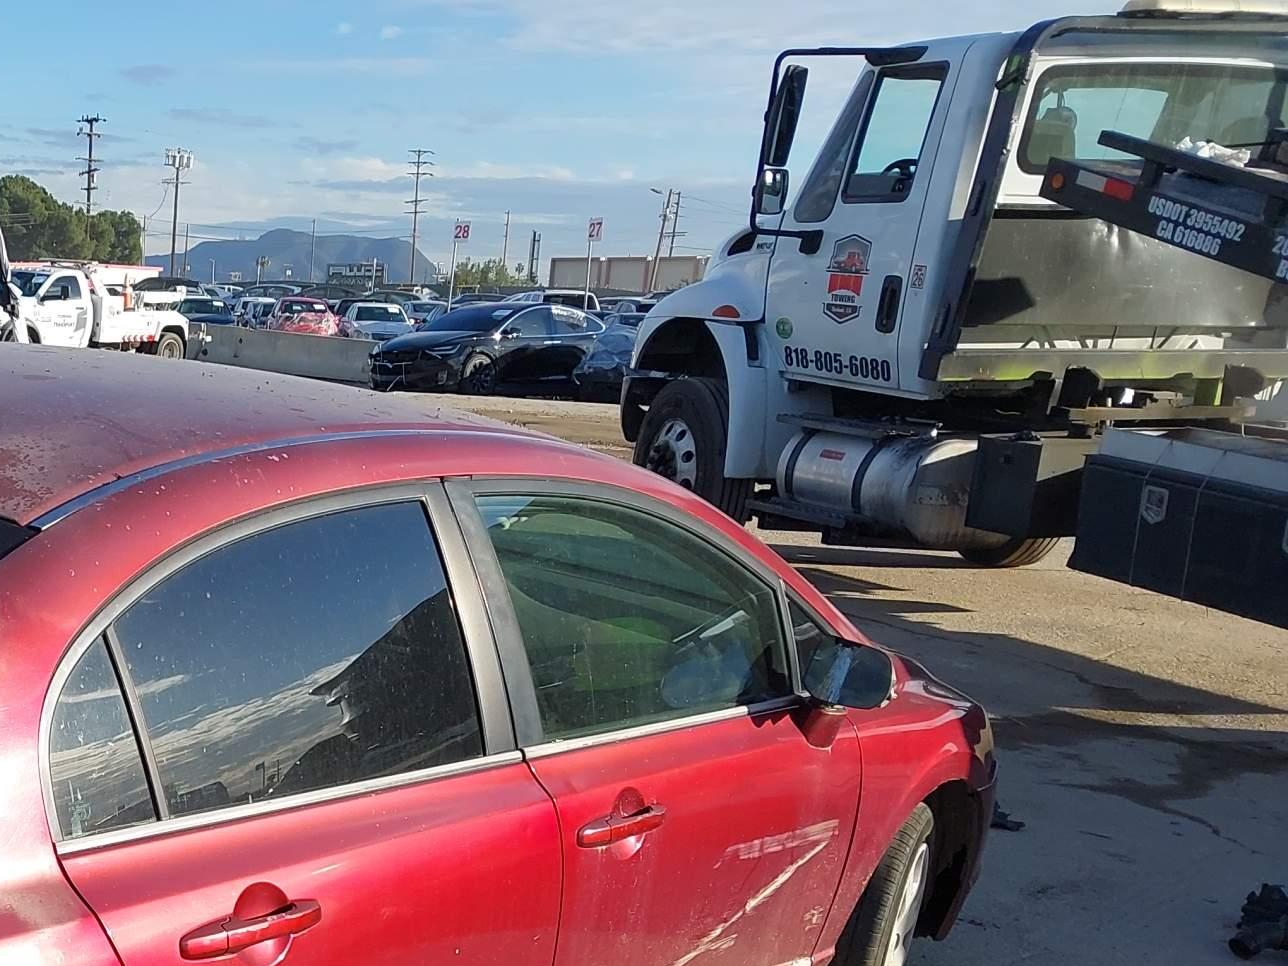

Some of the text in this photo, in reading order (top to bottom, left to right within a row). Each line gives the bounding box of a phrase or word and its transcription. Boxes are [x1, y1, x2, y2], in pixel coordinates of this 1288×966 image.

[1148, 196, 1246, 241] USDOT 3955492
[454, 224, 470, 239] 28
[588, 222, 603, 238] 27
[1156, 220, 1175, 240] CA
[912, 272, 924, 287] 26
[784, 345, 891, 382] 818-805-6080
